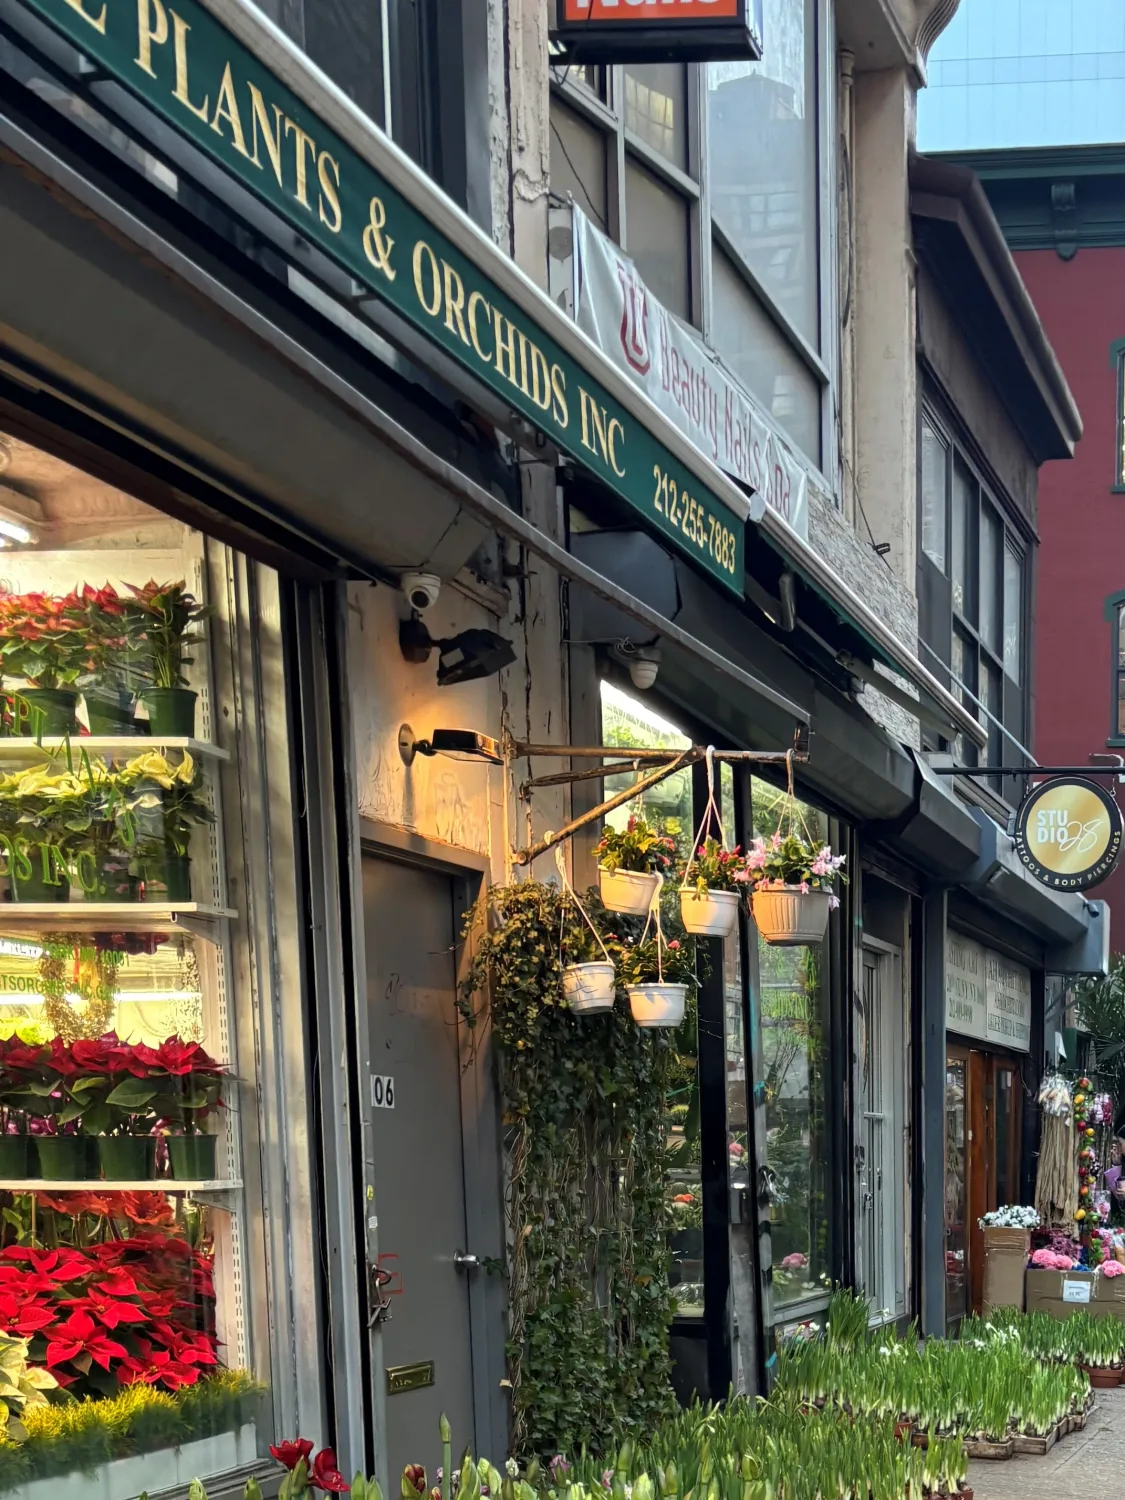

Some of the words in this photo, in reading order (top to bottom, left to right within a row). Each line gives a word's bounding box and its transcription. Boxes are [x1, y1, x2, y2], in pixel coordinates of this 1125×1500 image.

[134, 0, 343, 234] PLANTS
[362, 197, 397, 282] &
[412, 240, 569, 429] ORCHIDS
[577, 384, 626, 479] INC
[653, 464, 737, 575] 212-255-7883
[1037, 810, 1068, 827] STU
[1037, 826, 1069, 845] DIO
[1016, 831, 1041, 875] TATTOOS
[1054, 876, 1083, 886] BODY
[1087, 830, 1121, 880] PIERCINGS
[374, 1076, 394, 1106] 06
